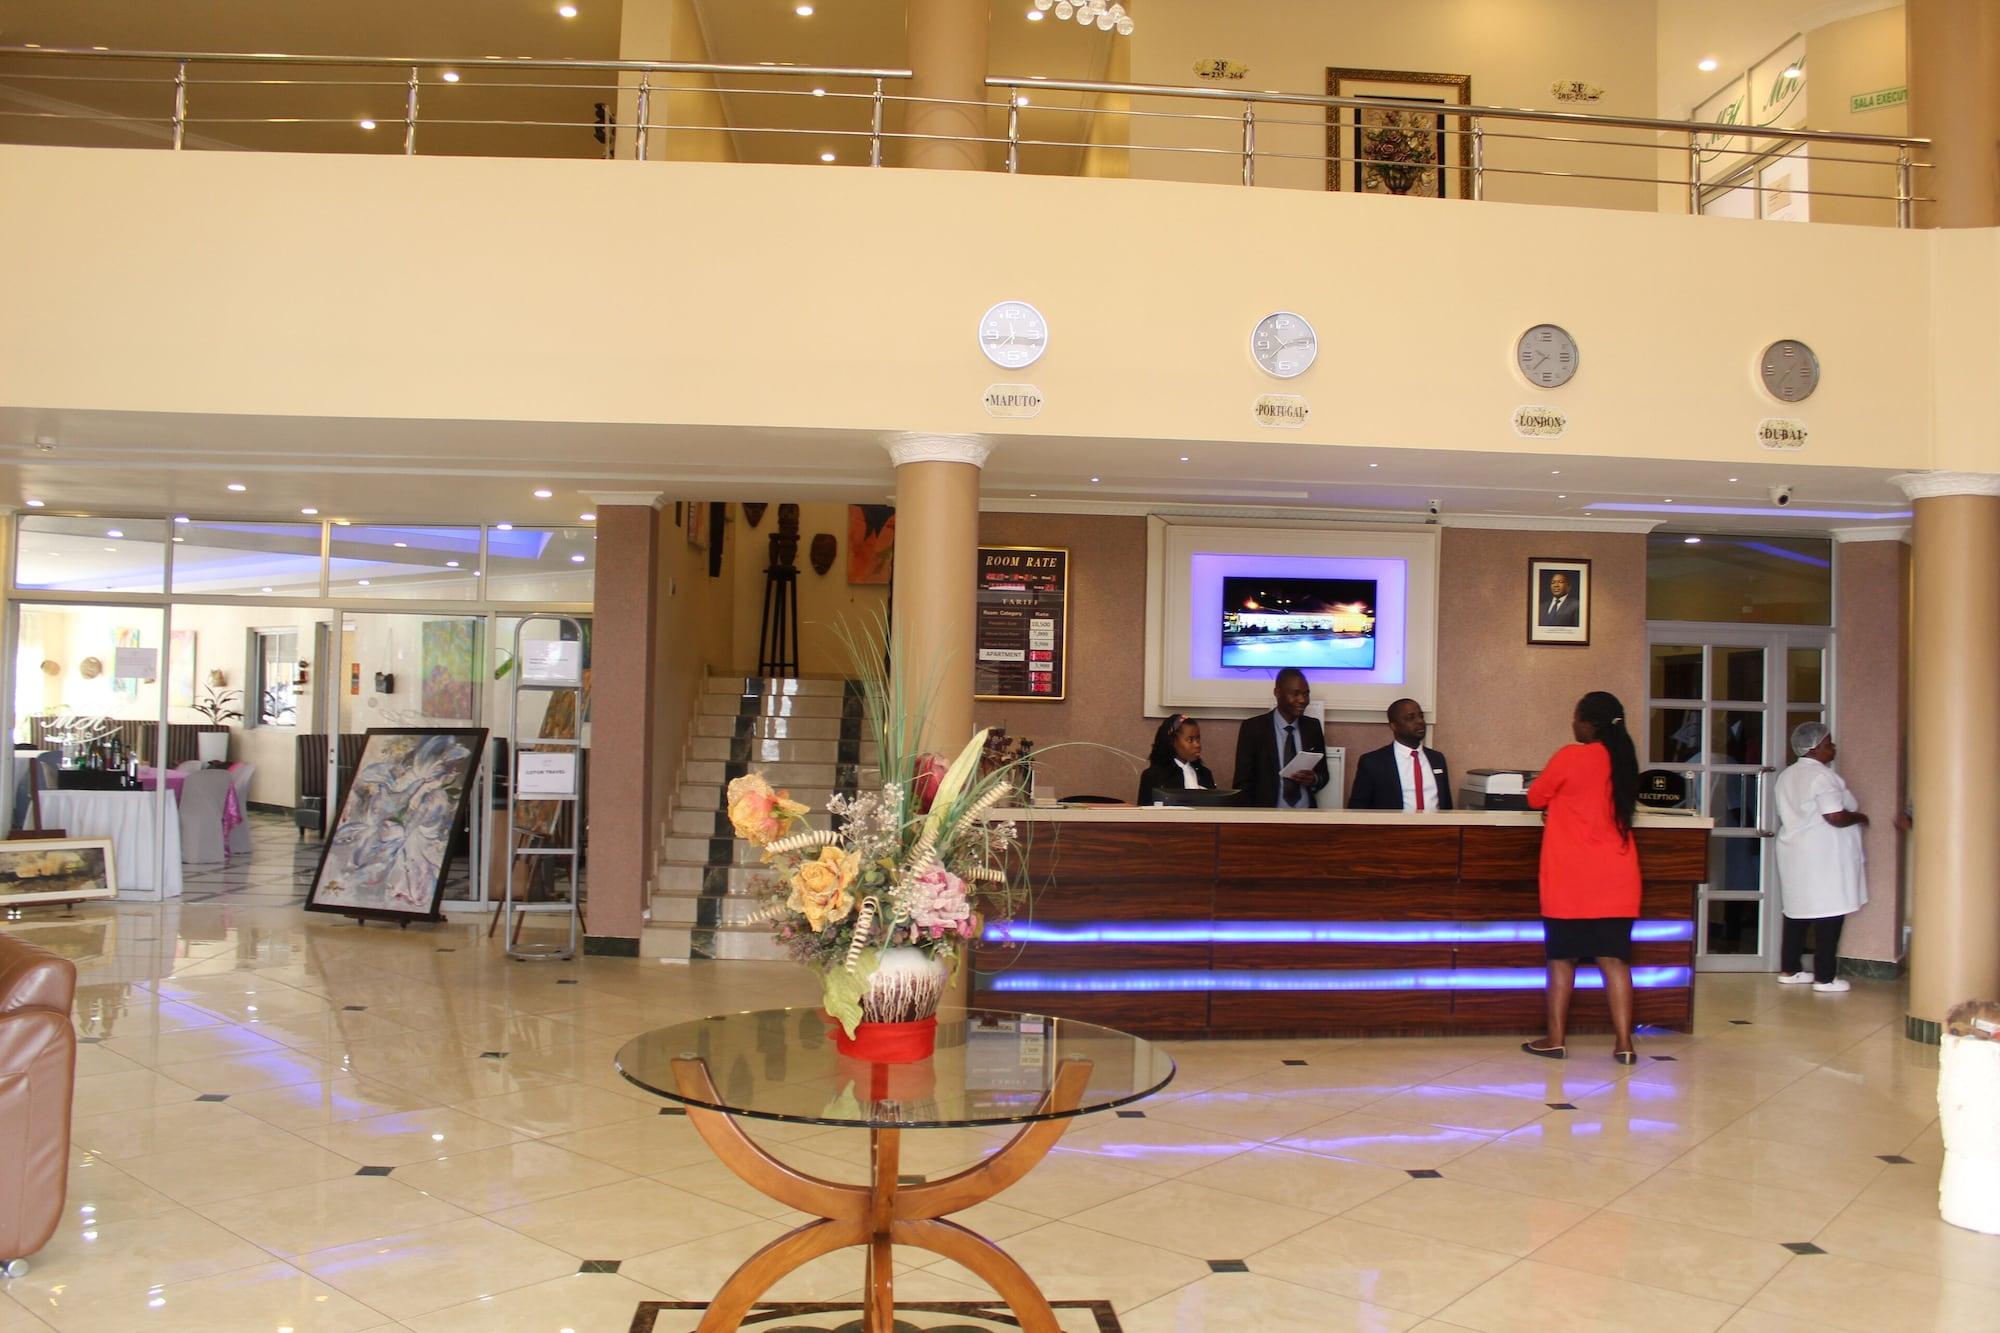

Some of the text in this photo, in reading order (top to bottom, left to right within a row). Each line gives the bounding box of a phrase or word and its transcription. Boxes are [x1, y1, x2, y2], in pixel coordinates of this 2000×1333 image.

[1854, 95, 1873, 109] SALA
[990, 394, 1037, 407] MAPUTO
[1258, 404, 1303, 418] PORTUGAL
[1520, 415, 1561, 428] LONDON
[1764, 428, 1803, 440] DUBAI
[986, 556, 1058, 568] ROOM RATE
[1638, 792, 1681, 801] RECEPTION
